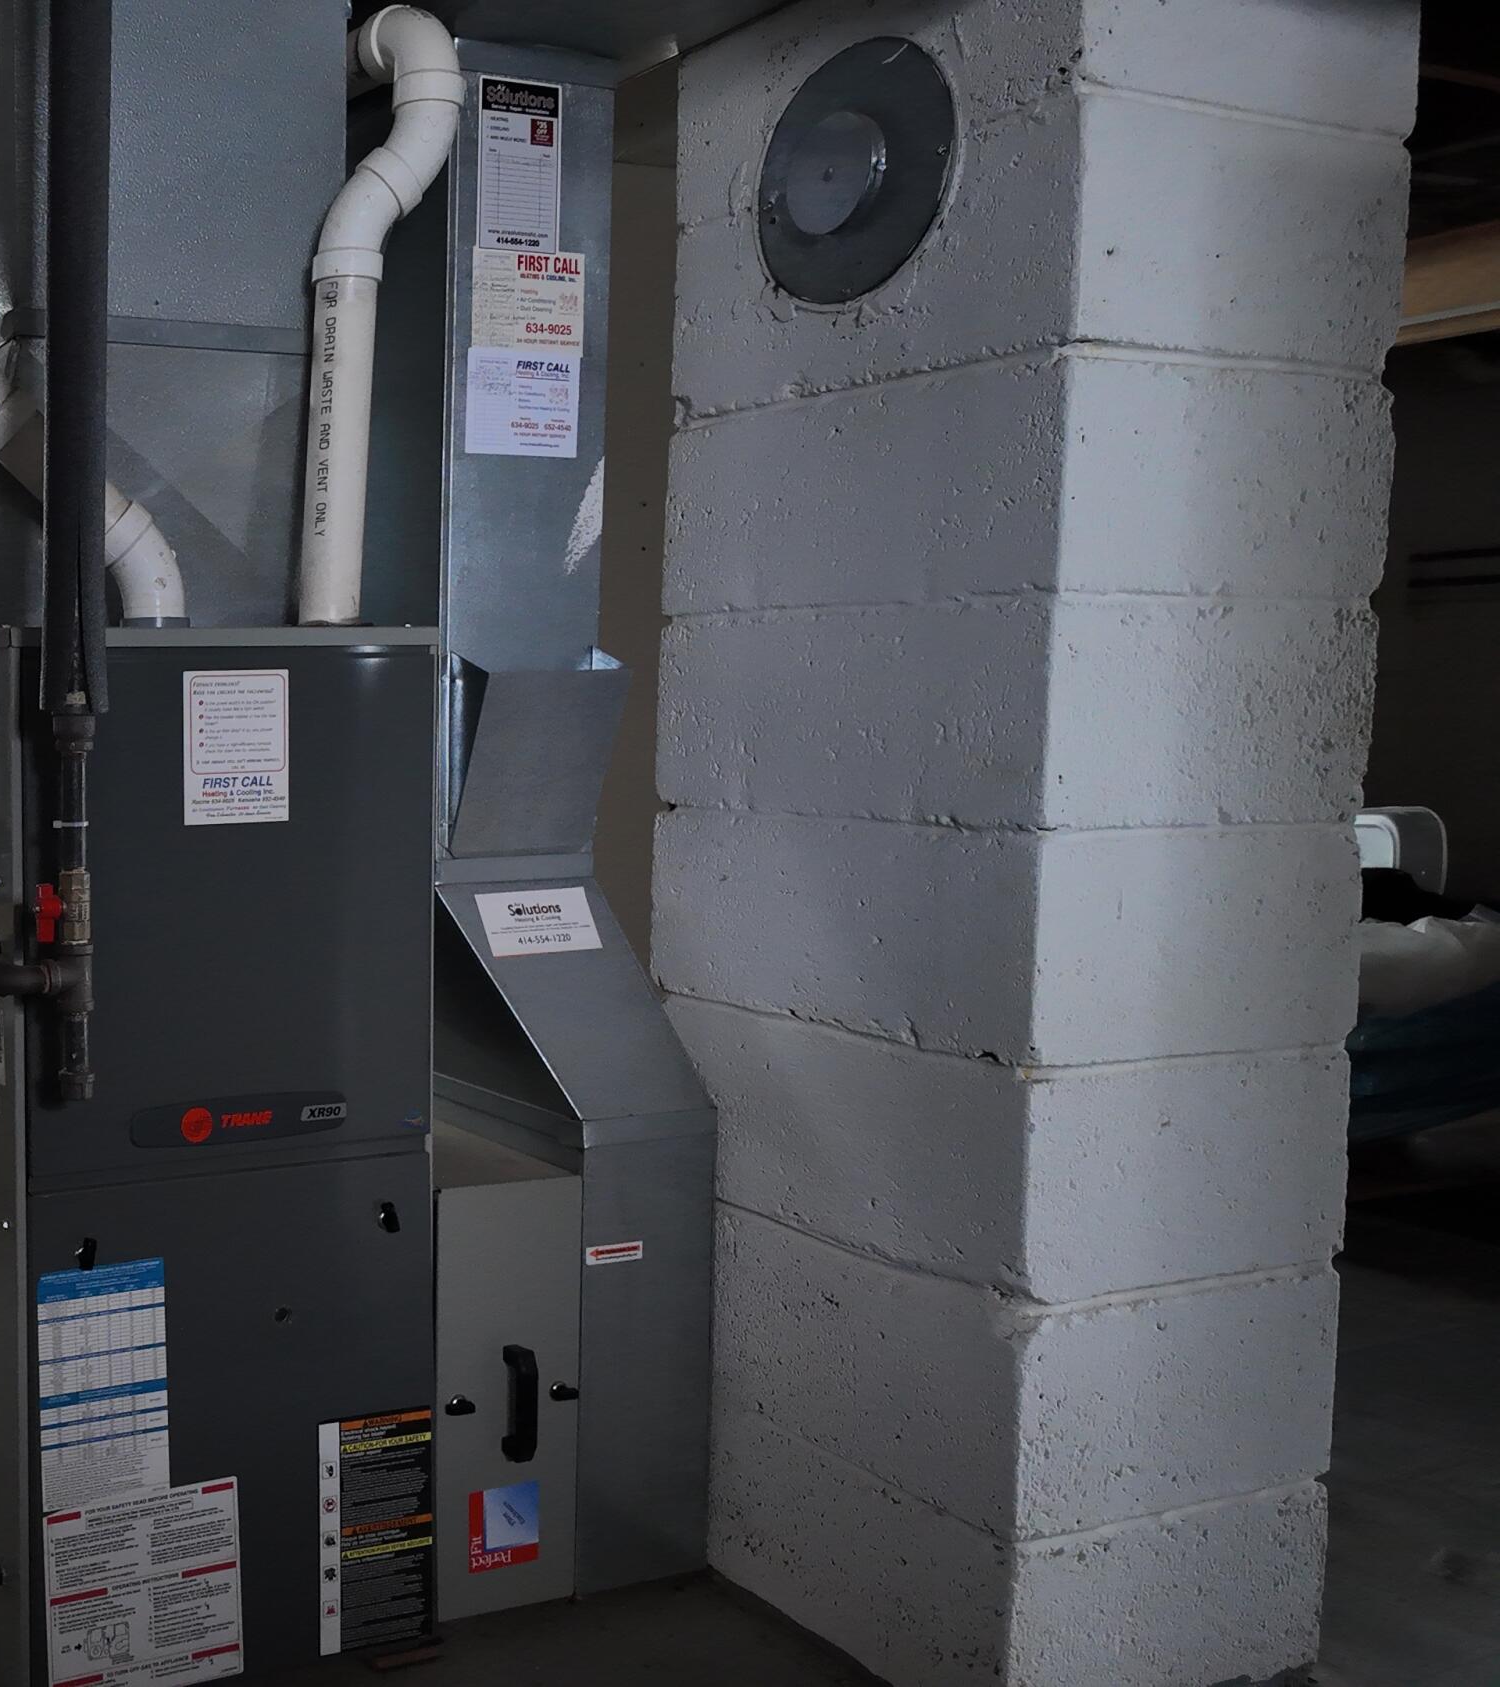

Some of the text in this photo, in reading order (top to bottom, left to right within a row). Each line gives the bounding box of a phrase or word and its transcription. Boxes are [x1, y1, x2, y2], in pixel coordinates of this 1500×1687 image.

[486, 85, 556, 110] Solutions
[517, 254, 581, 275] FIRST CALL
[525, 322, 572, 335] 634-9025
[516, 360, 571, 374] FIRST CALL
[315, 281, 338, 537] FOR DRAIN WASTE AND VENT ONLY
[510, 421, 540, 431] 634-9025
[202, 775, 273, 789] FIRST CALL
[507, 903, 562, 917] Solutions
[518, 933, 572, 945] 414-554-1220
[308, 1106, 341, 1119] XR90
[112, 1501, 132, 1510] SAFETY
[133, 1498, 147, 1506] READ
[169, 1488, 198, 1499] OPERATING
[470, 1535, 482, 1555] Fit
[472, 1550, 511, 1568] Perfect
